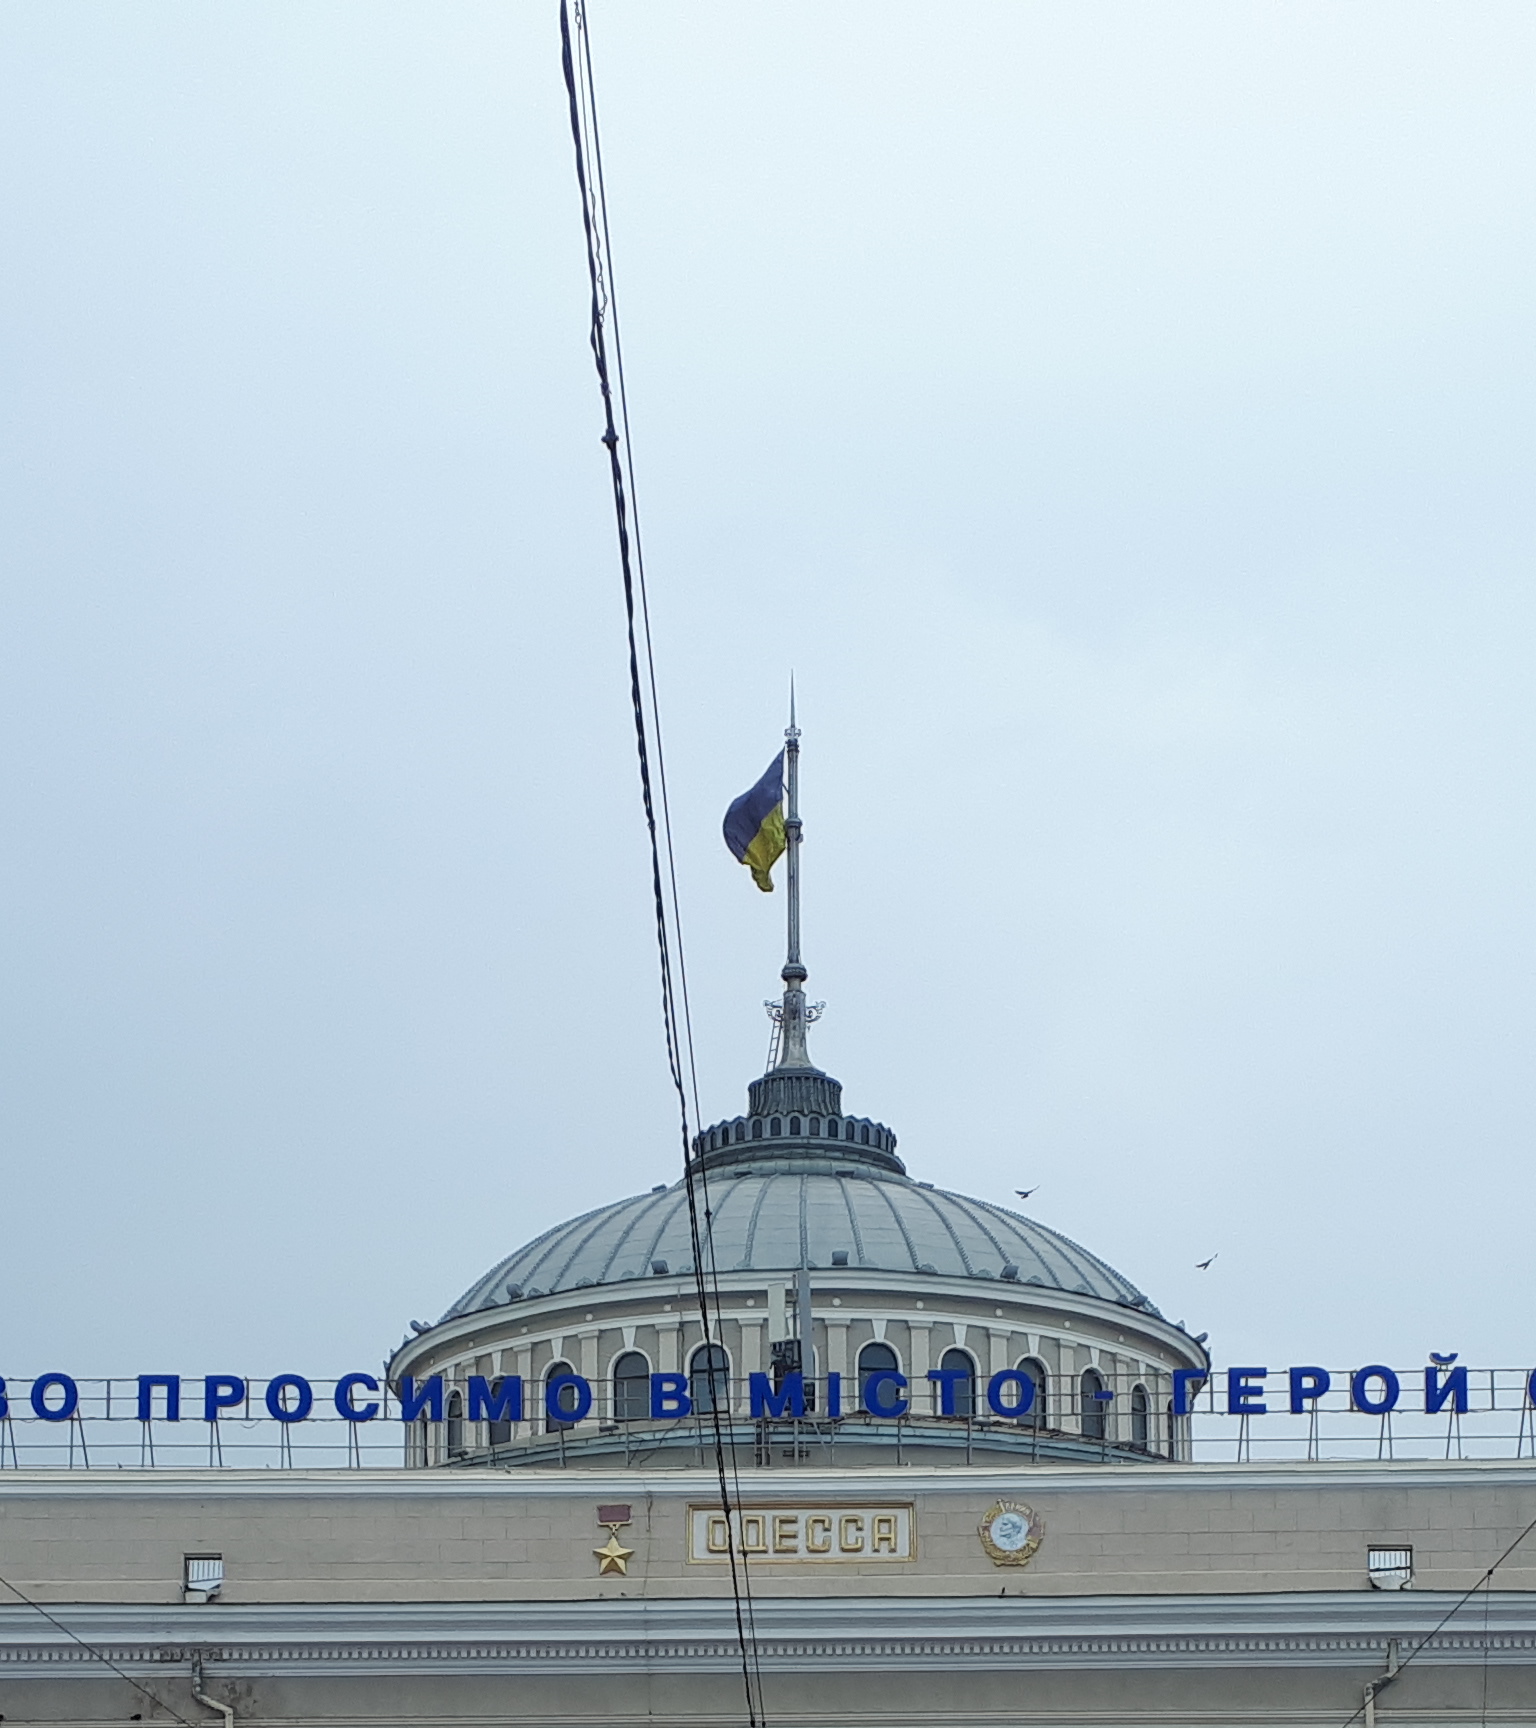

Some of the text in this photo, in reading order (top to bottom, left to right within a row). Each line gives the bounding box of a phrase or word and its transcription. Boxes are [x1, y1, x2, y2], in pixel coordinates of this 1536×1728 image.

[138, 1371, 591, 1423] ПРОСИМО
[650, 1372, 693, 1420] В
[707, 1513, 898, 1555] ОДЕССА
